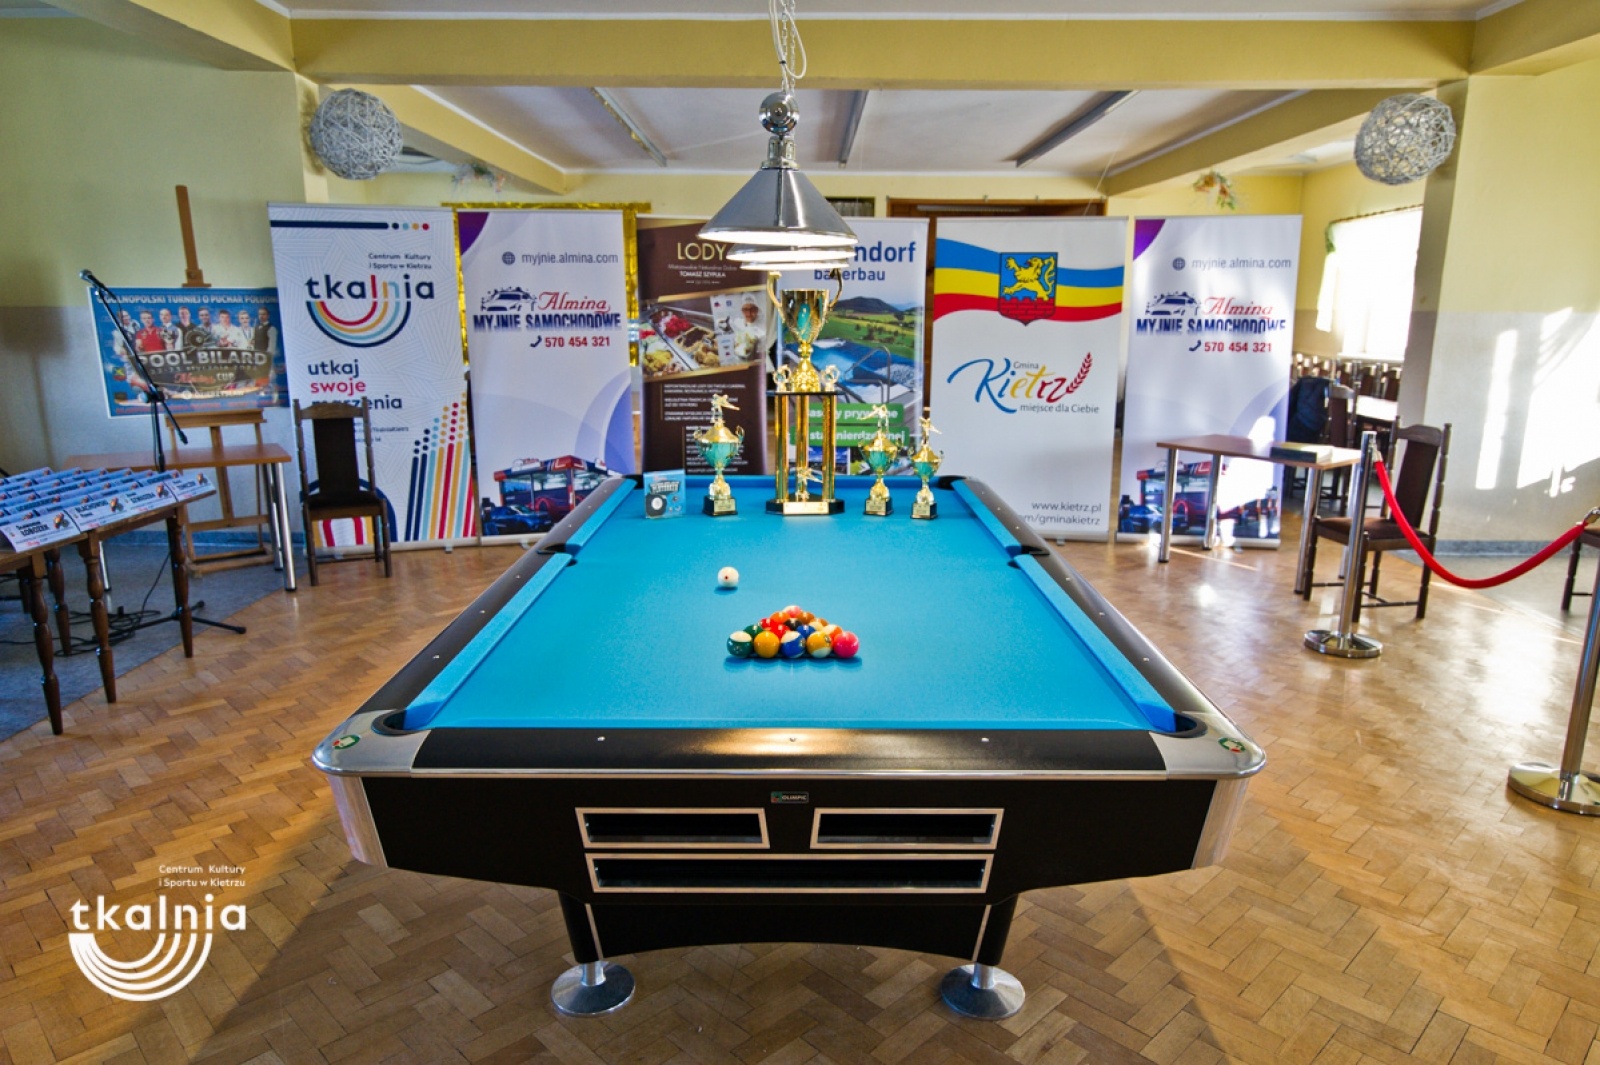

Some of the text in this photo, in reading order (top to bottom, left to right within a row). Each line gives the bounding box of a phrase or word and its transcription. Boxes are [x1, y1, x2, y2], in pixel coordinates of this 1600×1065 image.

[521, 251, 619, 266] myjnie.almina.com
[676, 242, 727, 261] LODY
[854, 241, 917, 262] ndorf
[1191, 257, 1292, 271] myjnie.almina.com
[304, 273, 435, 300] tkalnia
[537, 291, 611, 315] Almina
[473, 312, 622, 332] MYJNIE SAMOCHODOWE
[1135, 318, 1287, 335] MYJNIE SAMOCHODOWE
[545, 335, 611, 348] 570 454 321
[1204, 341, 1273, 352] 570 454 321
[197, 349, 268, 366] BILARD
[1013, 361, 1040, 370] Gmina
[307, 359, 360, 378] utkaj
[310, 378, 367, 397] swoje
[946, 357, 1073, 414] Kietrz
[1020, 404, 1100, 414] miejsce dla Ciebie
[1030, 501, 1102, 514] www.kietrz.pl
[1018, 513, 1101, 526] m/gminakietrz
